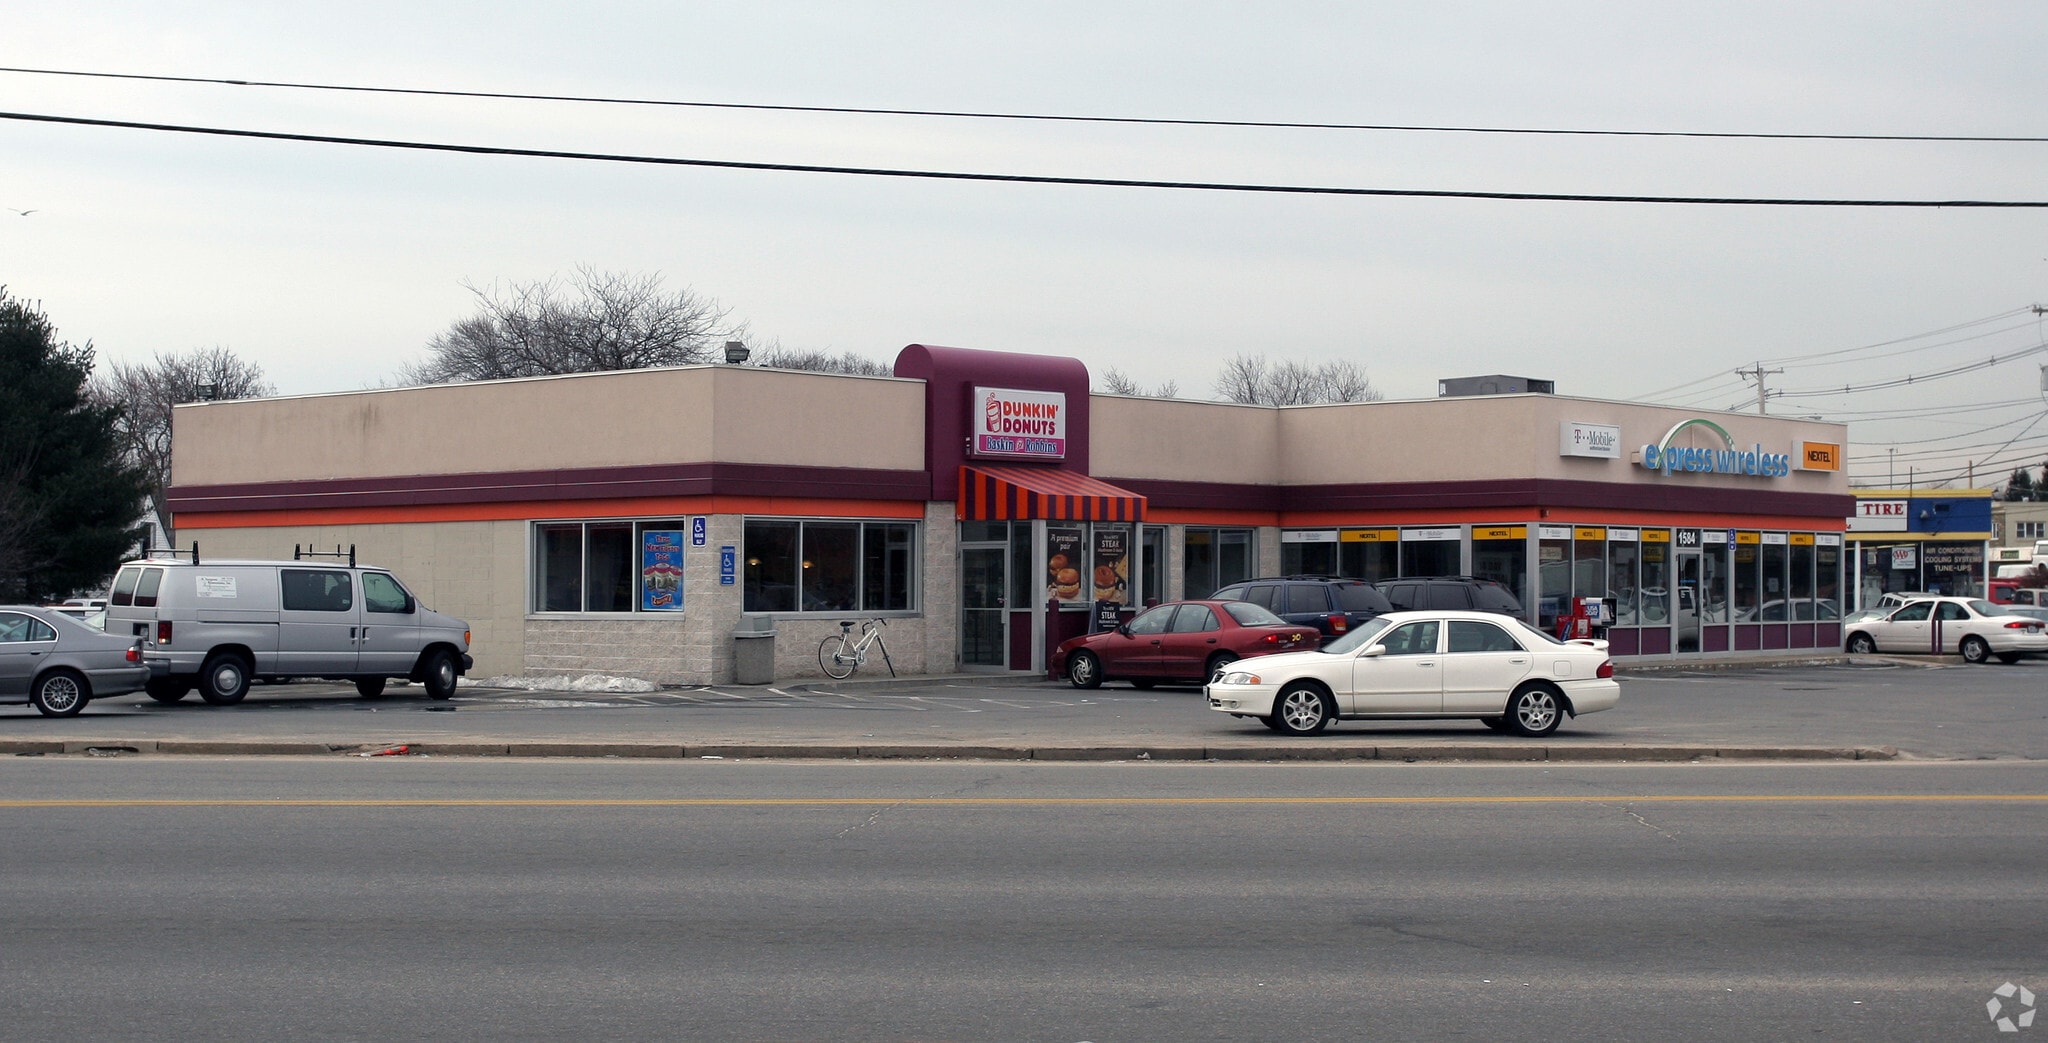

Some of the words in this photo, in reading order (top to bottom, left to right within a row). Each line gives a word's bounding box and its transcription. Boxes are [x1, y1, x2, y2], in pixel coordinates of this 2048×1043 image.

[1003, 401, 1058, 419] DUNKIN'
[1003, 418, 1056, 435] DONUTS
[986, 436, 1014, 451] Baskin
[1026, 438, 1057, 453] Robbins
[1645, 444, 1713, 477] express
[1716, 443, 1789, 477] wireless
[1807, 450, 1831, 462] NEXTEL
[1863, 503, 1904, 516] TIRE
[1101, 540, 1120, 548] STEAK
[1678, 532, 1696, 544] 1584
[1934, 564, 1972, 572] TUNE-UPS
[1101, 611, 1116, 619] STEAK
